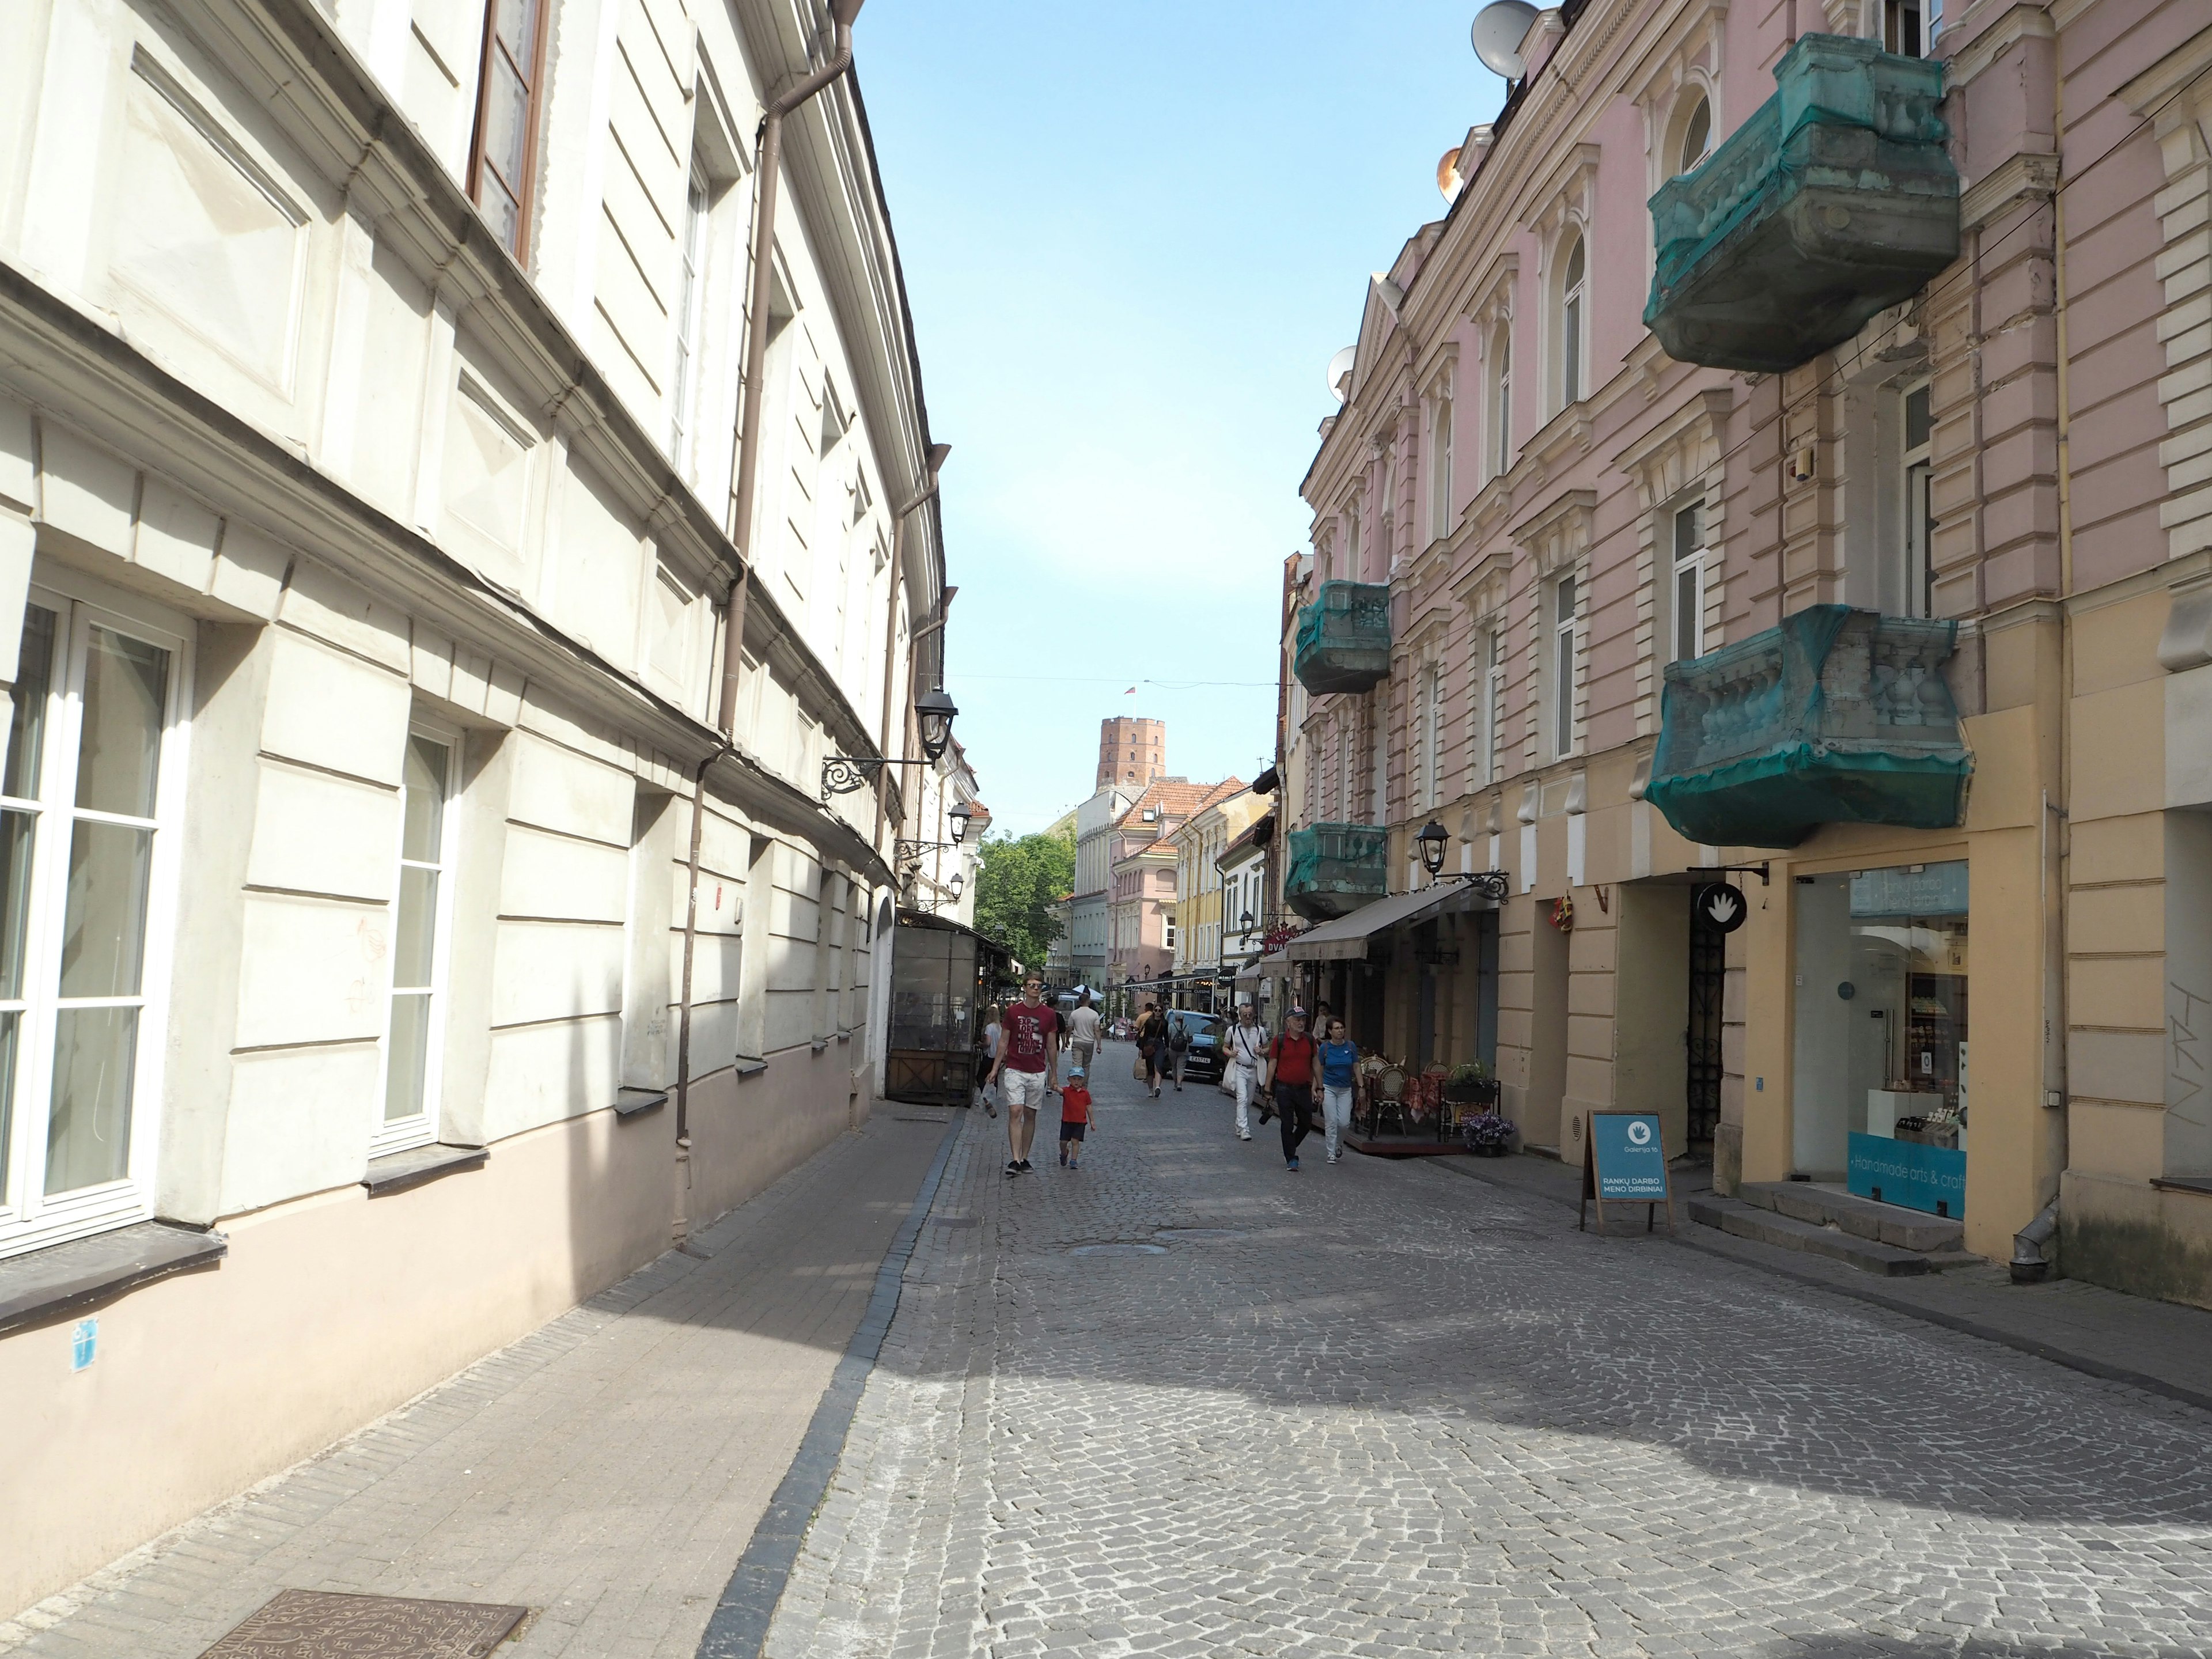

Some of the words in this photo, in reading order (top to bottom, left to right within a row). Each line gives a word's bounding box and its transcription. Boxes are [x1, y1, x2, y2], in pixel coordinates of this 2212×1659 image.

[1854, 1154, 1908, 1179] Handmade
[1910, 1166, 1928, 1183] arts
[1930, 1170, 1938, 1184] &
[1603, 1178, 1630, 1186] RANKŲ
